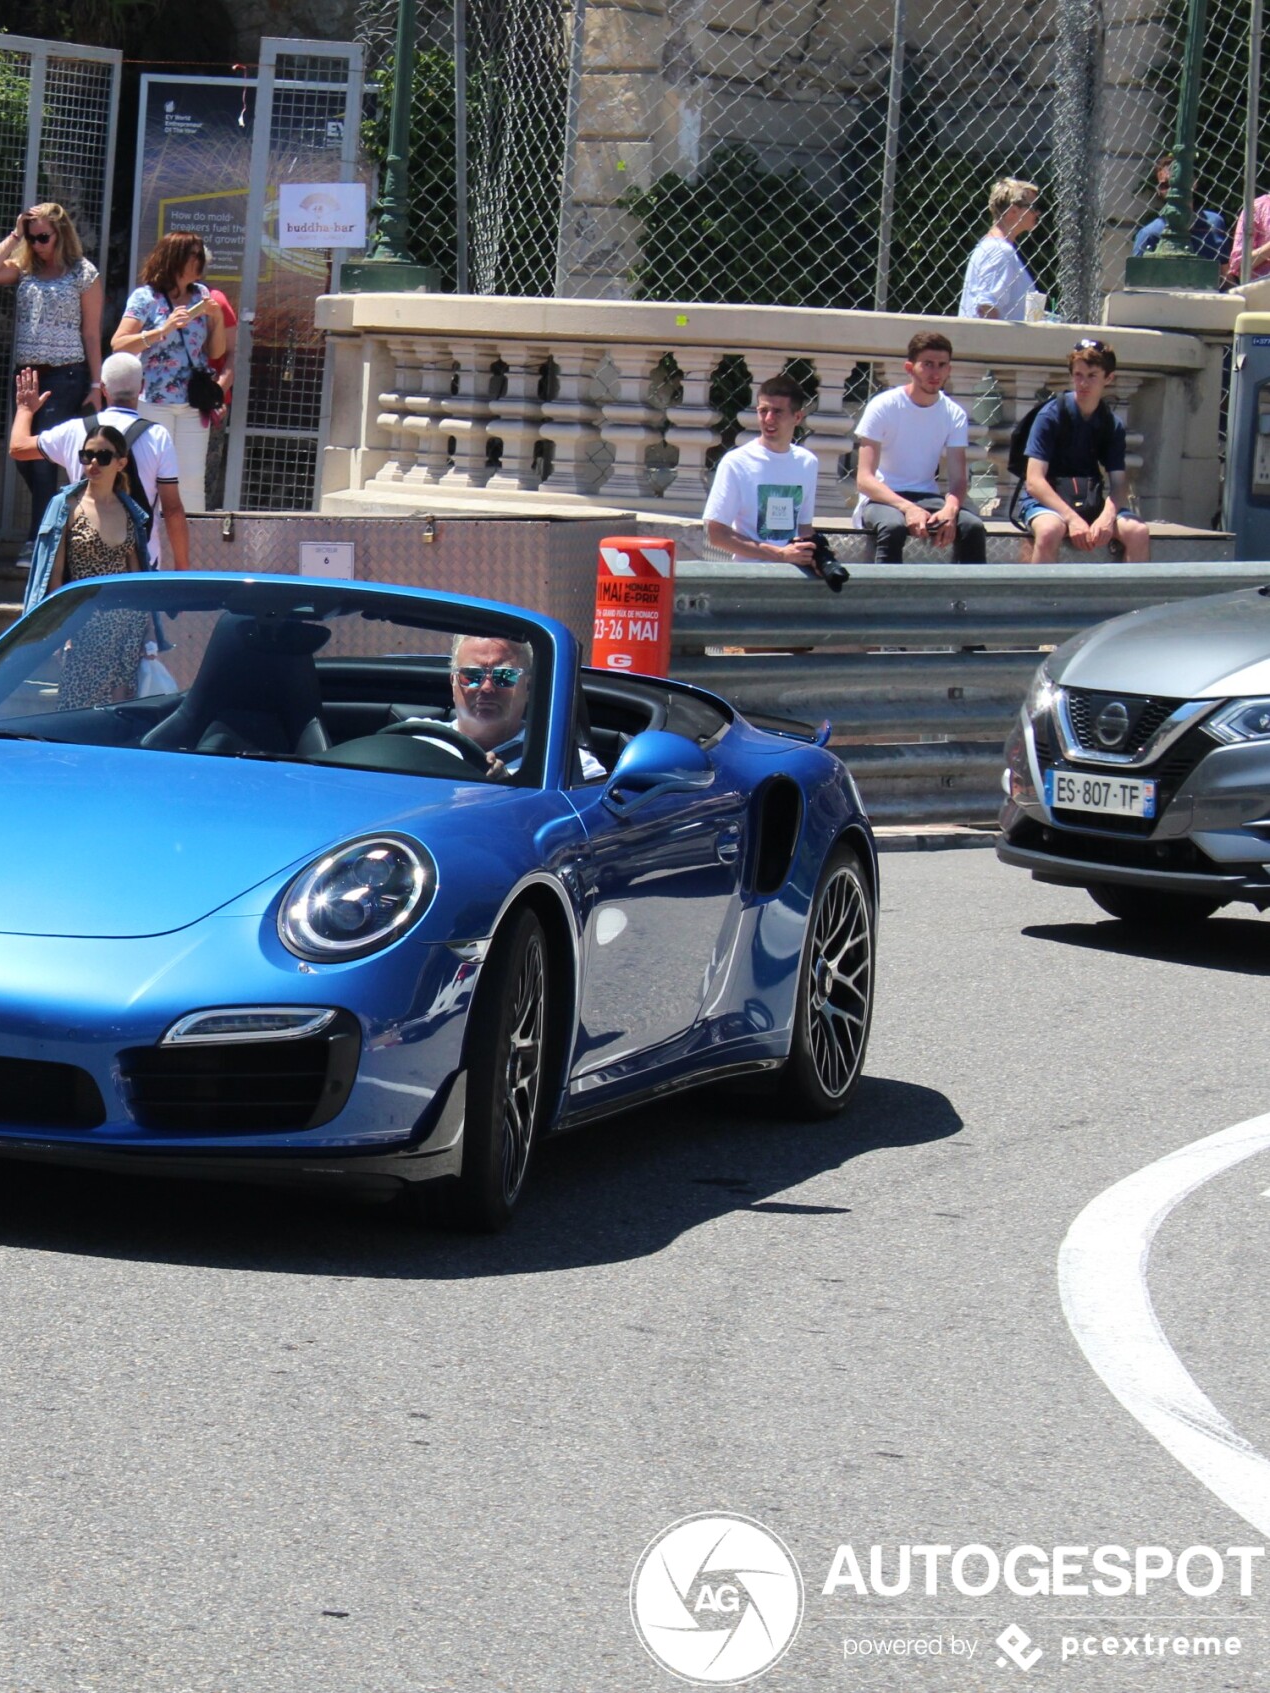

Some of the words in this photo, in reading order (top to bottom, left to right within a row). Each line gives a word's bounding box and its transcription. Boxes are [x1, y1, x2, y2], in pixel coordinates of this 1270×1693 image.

[171, 211, 191, 220] How
[193, 212, 206, 221] do
[208, 213, 234, 222] mold-
[170, 222, 210, 232] breakers
[212, 223, 230, 233] fuel
[287, 222, 355, 233] buddha-bar
[203, 236, 212, 244] of
[603, 582, 623, 602] MAI
[625, 582, 660, 593] MONACO
[624, 591, 659, 604] E-PRIX
[627, 610, 635, 619] DE
[635, 611, 659, 620] MONACO
[594, 619, 623, 640] 23-26
[628, 620, 659, 642] MAI
